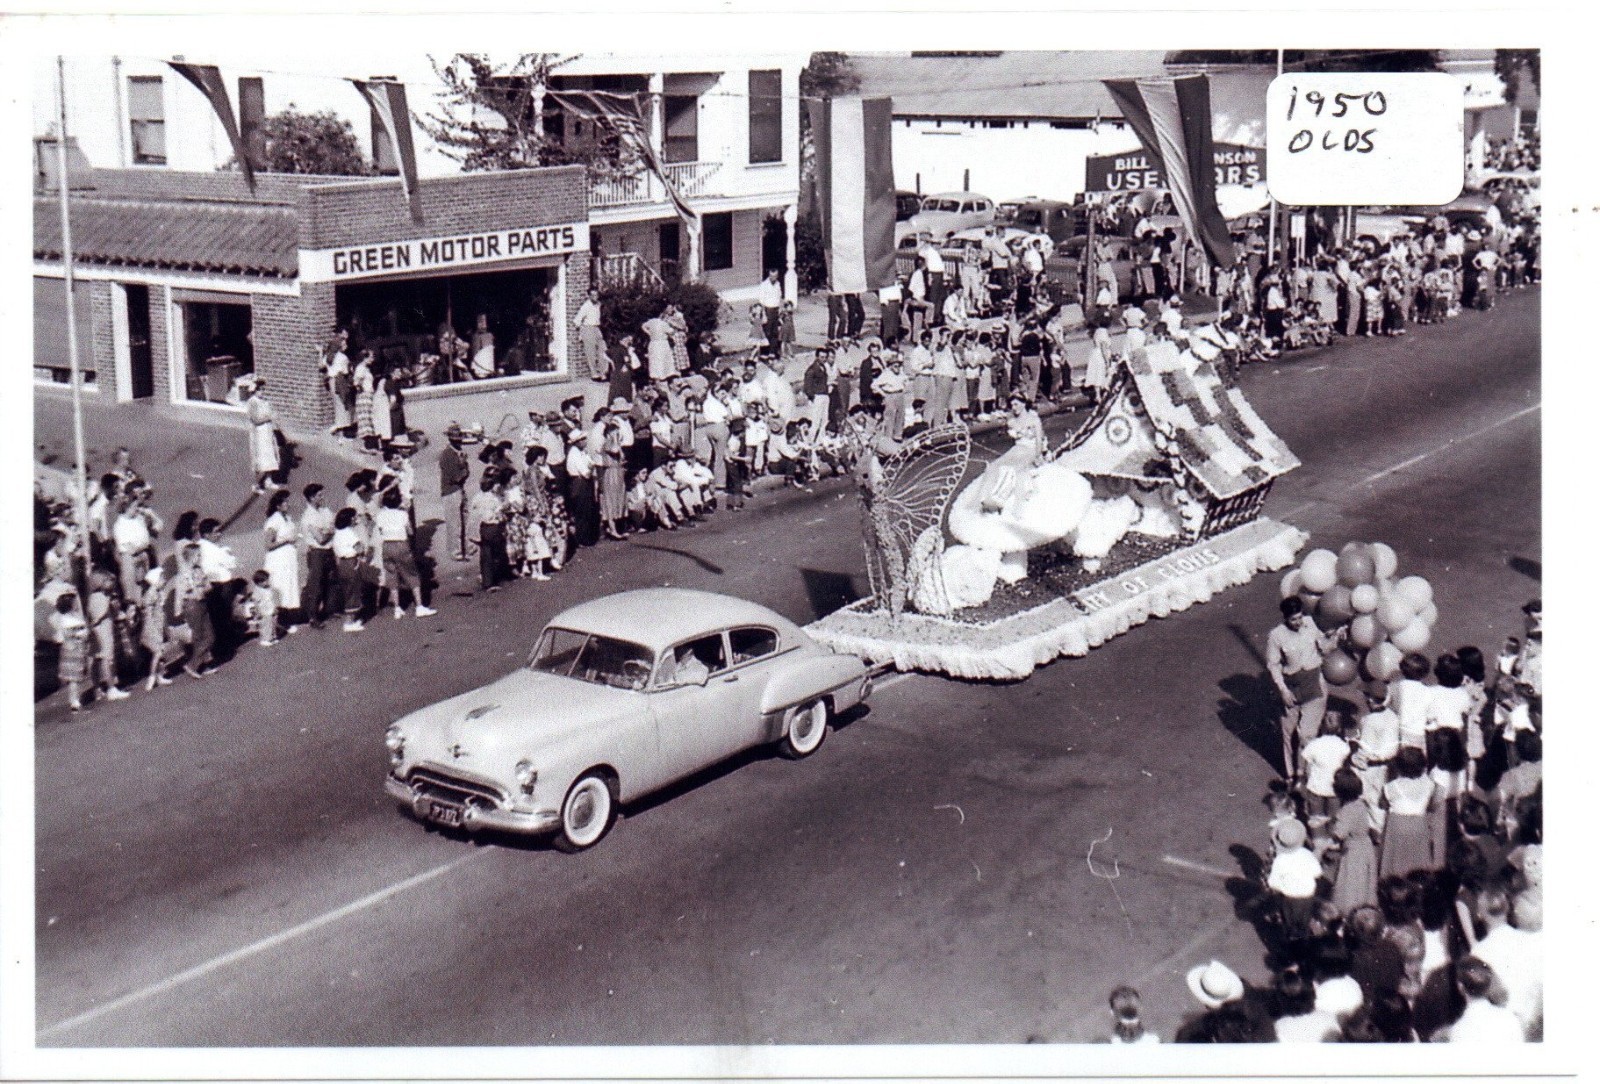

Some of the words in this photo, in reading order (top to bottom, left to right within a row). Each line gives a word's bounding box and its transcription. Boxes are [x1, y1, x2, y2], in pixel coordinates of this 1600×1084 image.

[1287, 86, 1387, 121] 1950
[1288, 128, 1378, 153] OLDS
[1115, 157, 1149, 171] BILL
[1106, 171, 1167, 190] USE
[333, 244, 410, 275] GREEN
[420, 234, 500, 266] MOTOR
[508, 226, 574, 254] PARTS
